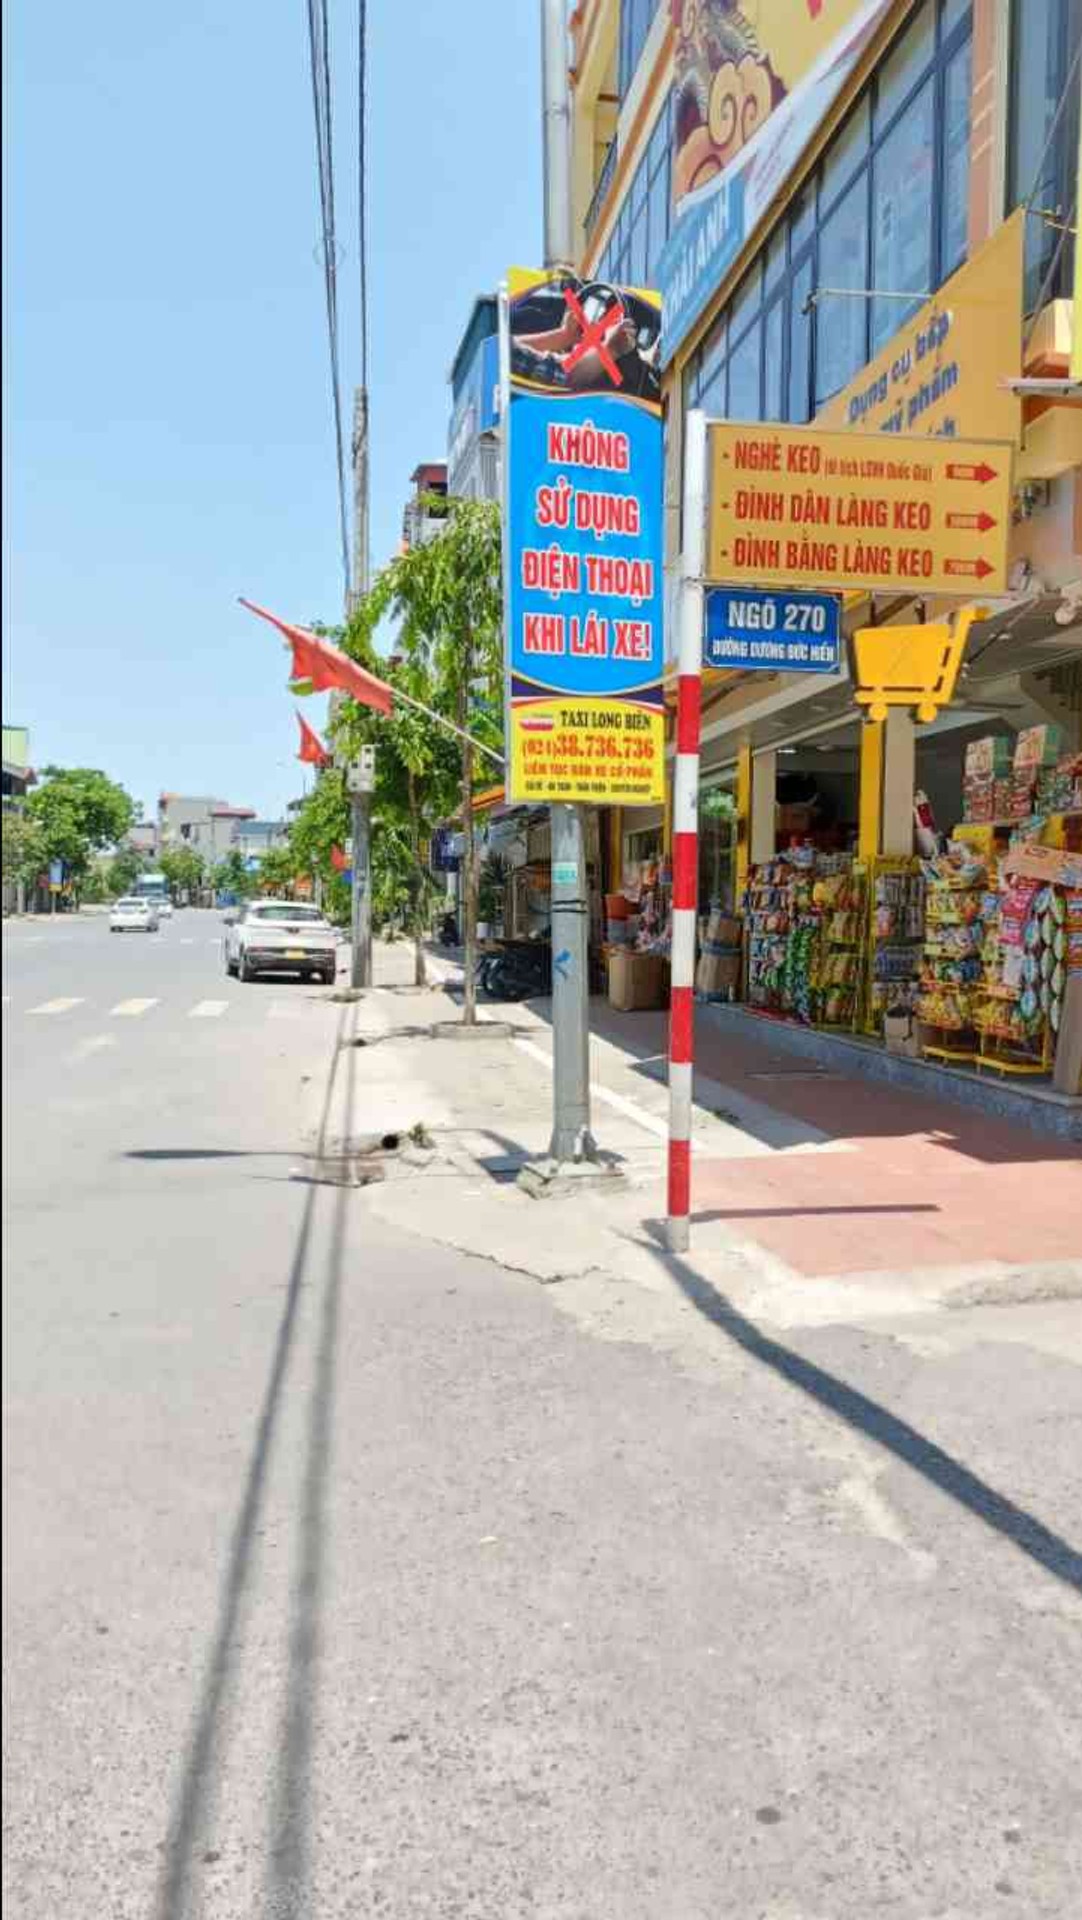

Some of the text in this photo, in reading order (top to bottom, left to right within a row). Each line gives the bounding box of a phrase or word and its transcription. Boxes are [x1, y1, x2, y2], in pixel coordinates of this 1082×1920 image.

[548, 420, 630, 471] KHÔNG
[787, 444, 821, 475] KEO
[537, 476, 640, 539] SỬ DỤNG
[735, 484, 931, 530] ĐÌNH DÂN LÀNG KEO
[522, 544, 652, 606] ĐIỆN THOẠI
[734, 532, 780, 569] ĐÌNH
[843, 539, 892, 575] LÀNG
[898, 547, 933, 577] KEO
[523, 610, 652, 660] KHI LÁI XE!
[727, 597, 826, 633] NGÕ 270
[561, 710, 588, 728] TAXI
[592, 712, 622, 730] LONG
